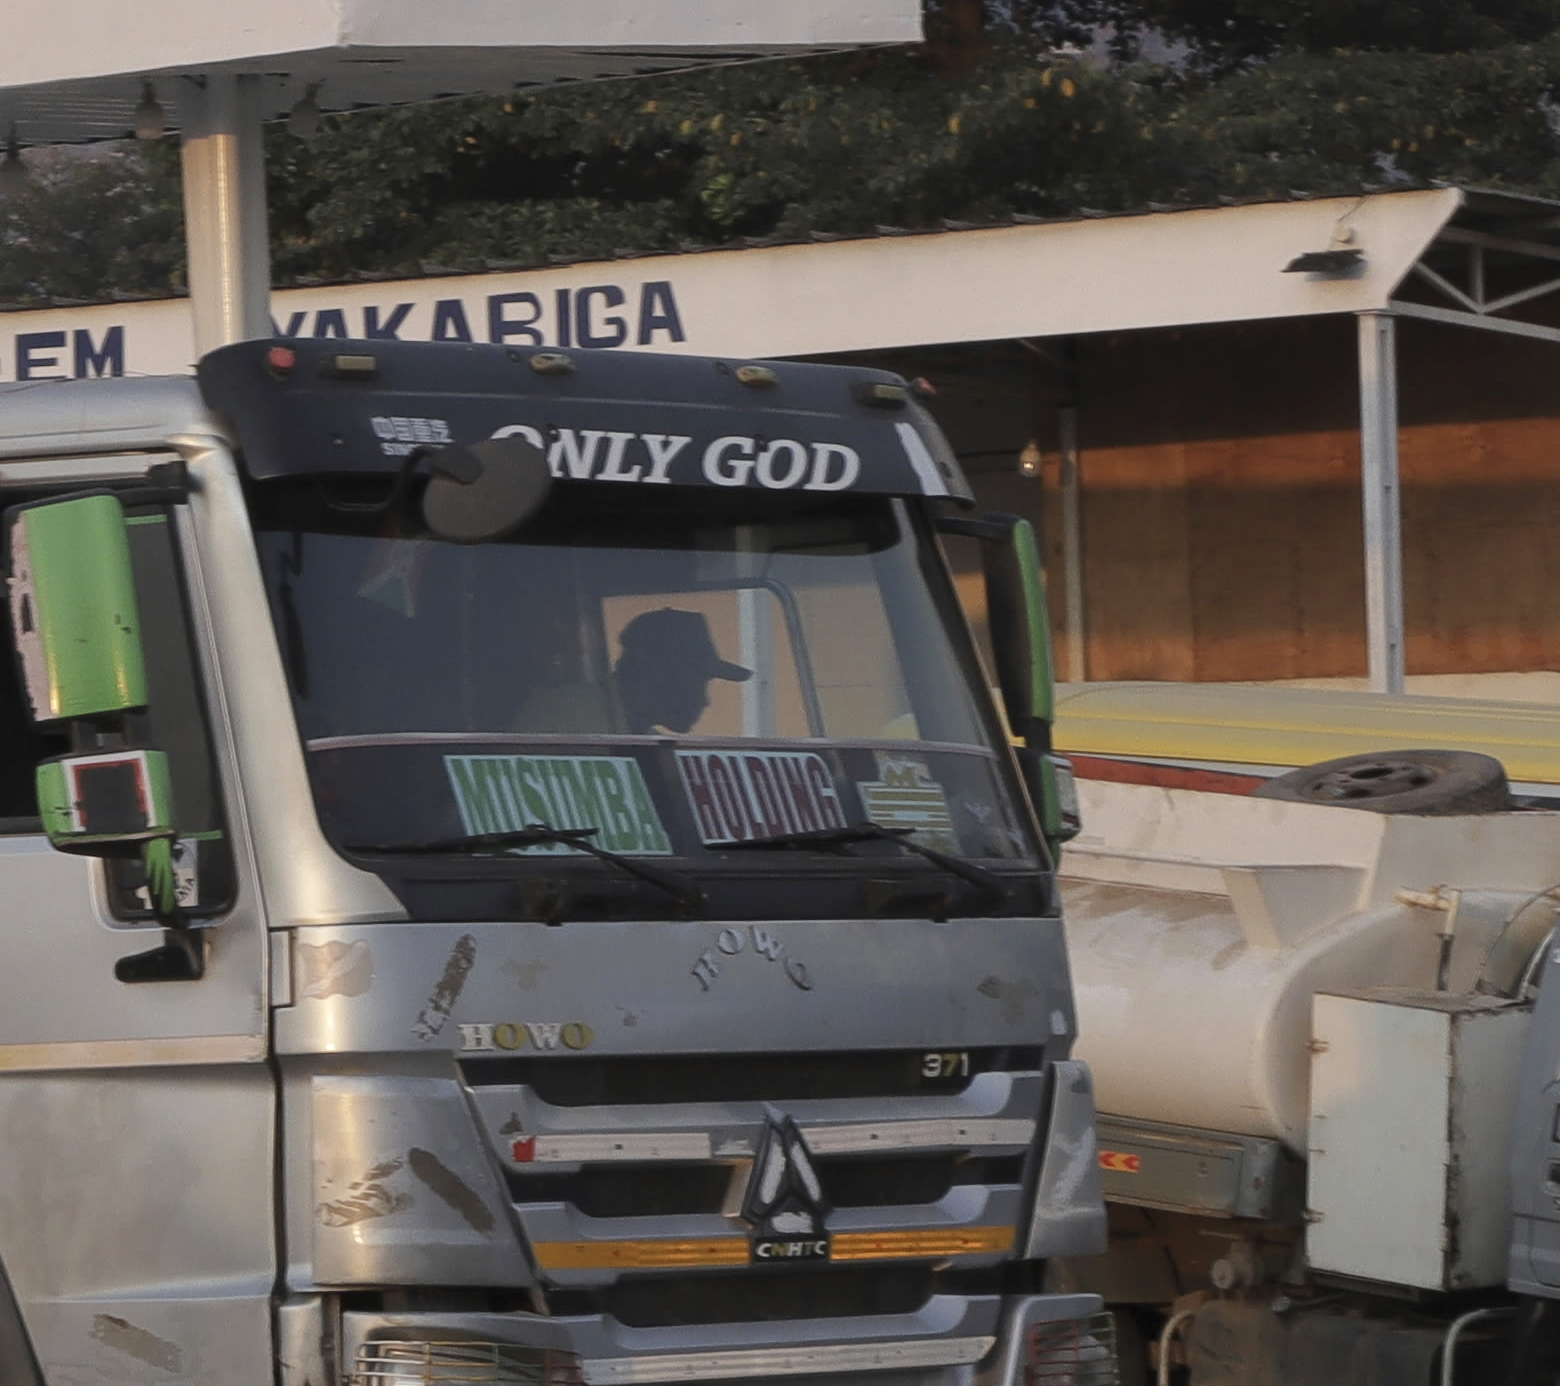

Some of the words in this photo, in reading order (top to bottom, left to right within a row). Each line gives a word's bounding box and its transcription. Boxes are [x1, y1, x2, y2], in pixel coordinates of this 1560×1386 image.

[702, 434, 860, 492] GOD
[452, 756, 668, 855] MUSUMBA
[680, 752, 844, 845] HOLDING
[457, 1021, 594, 1051] HOWO
[921, 1051, 971, 1079] 371
